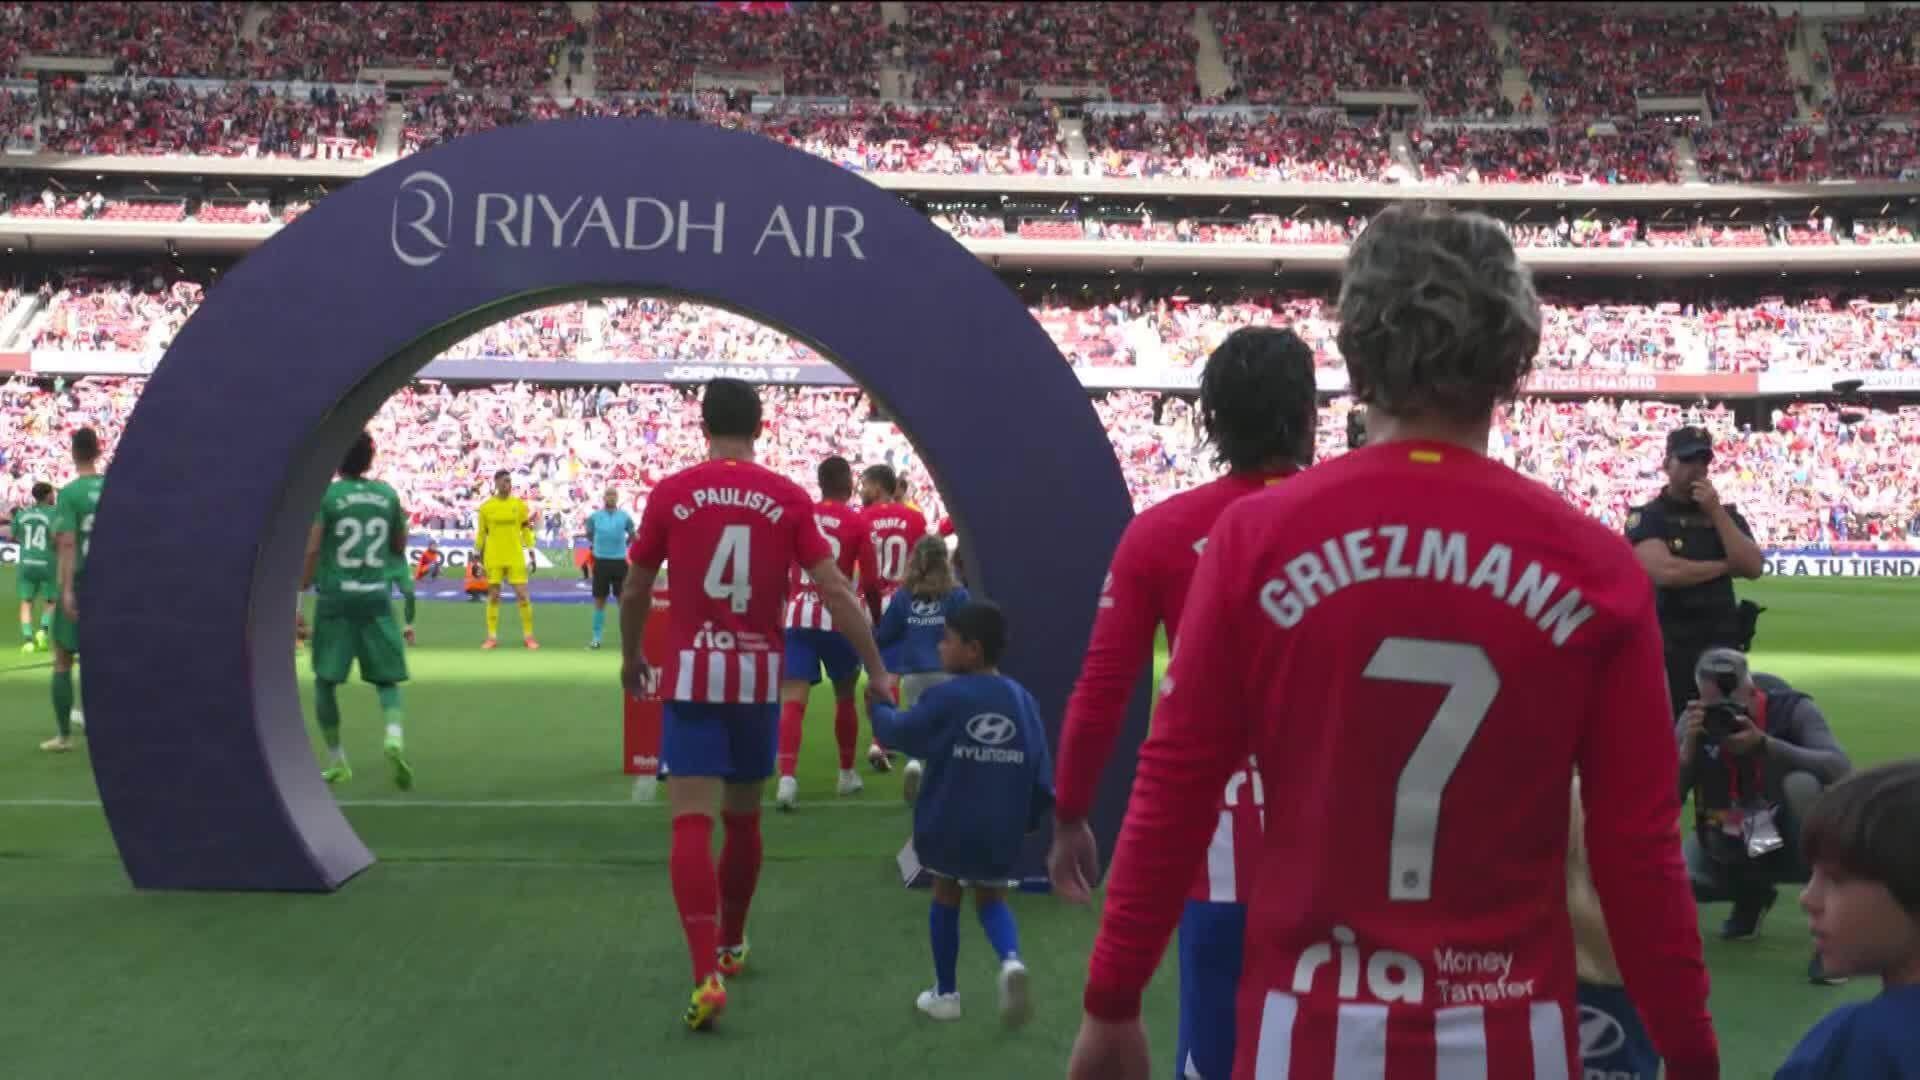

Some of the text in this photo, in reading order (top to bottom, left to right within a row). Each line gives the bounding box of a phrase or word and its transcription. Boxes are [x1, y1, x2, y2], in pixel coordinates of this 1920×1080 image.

[475, 193, 724, 254] RIYADH
[753, 205, 865, 260] AIR
[771, 367, 800, 381] 37
[692, 487, 785, 524] PAULISTA
[23, 523, 47, 551] 14
[335, 517, 389, 568] 22
[703, 524, 753, 614] 4
[1259, 525, 1596, 647] GRIEZMANN
[1794, 559, 1808, 576] A
[1815, 559, 1843, 576] TU
[1850, 559, 1920, 576] TIEND
[693, 621, 736, 650] ria
[952, 744, 1024, 764] HYUNDAI
[1361, 636, 1501, 901] 7
[1224, 752, 1264, 807] ri
[1292, 924, 1425, 1005] ria
[1433, 948, 1514, 978] Money
